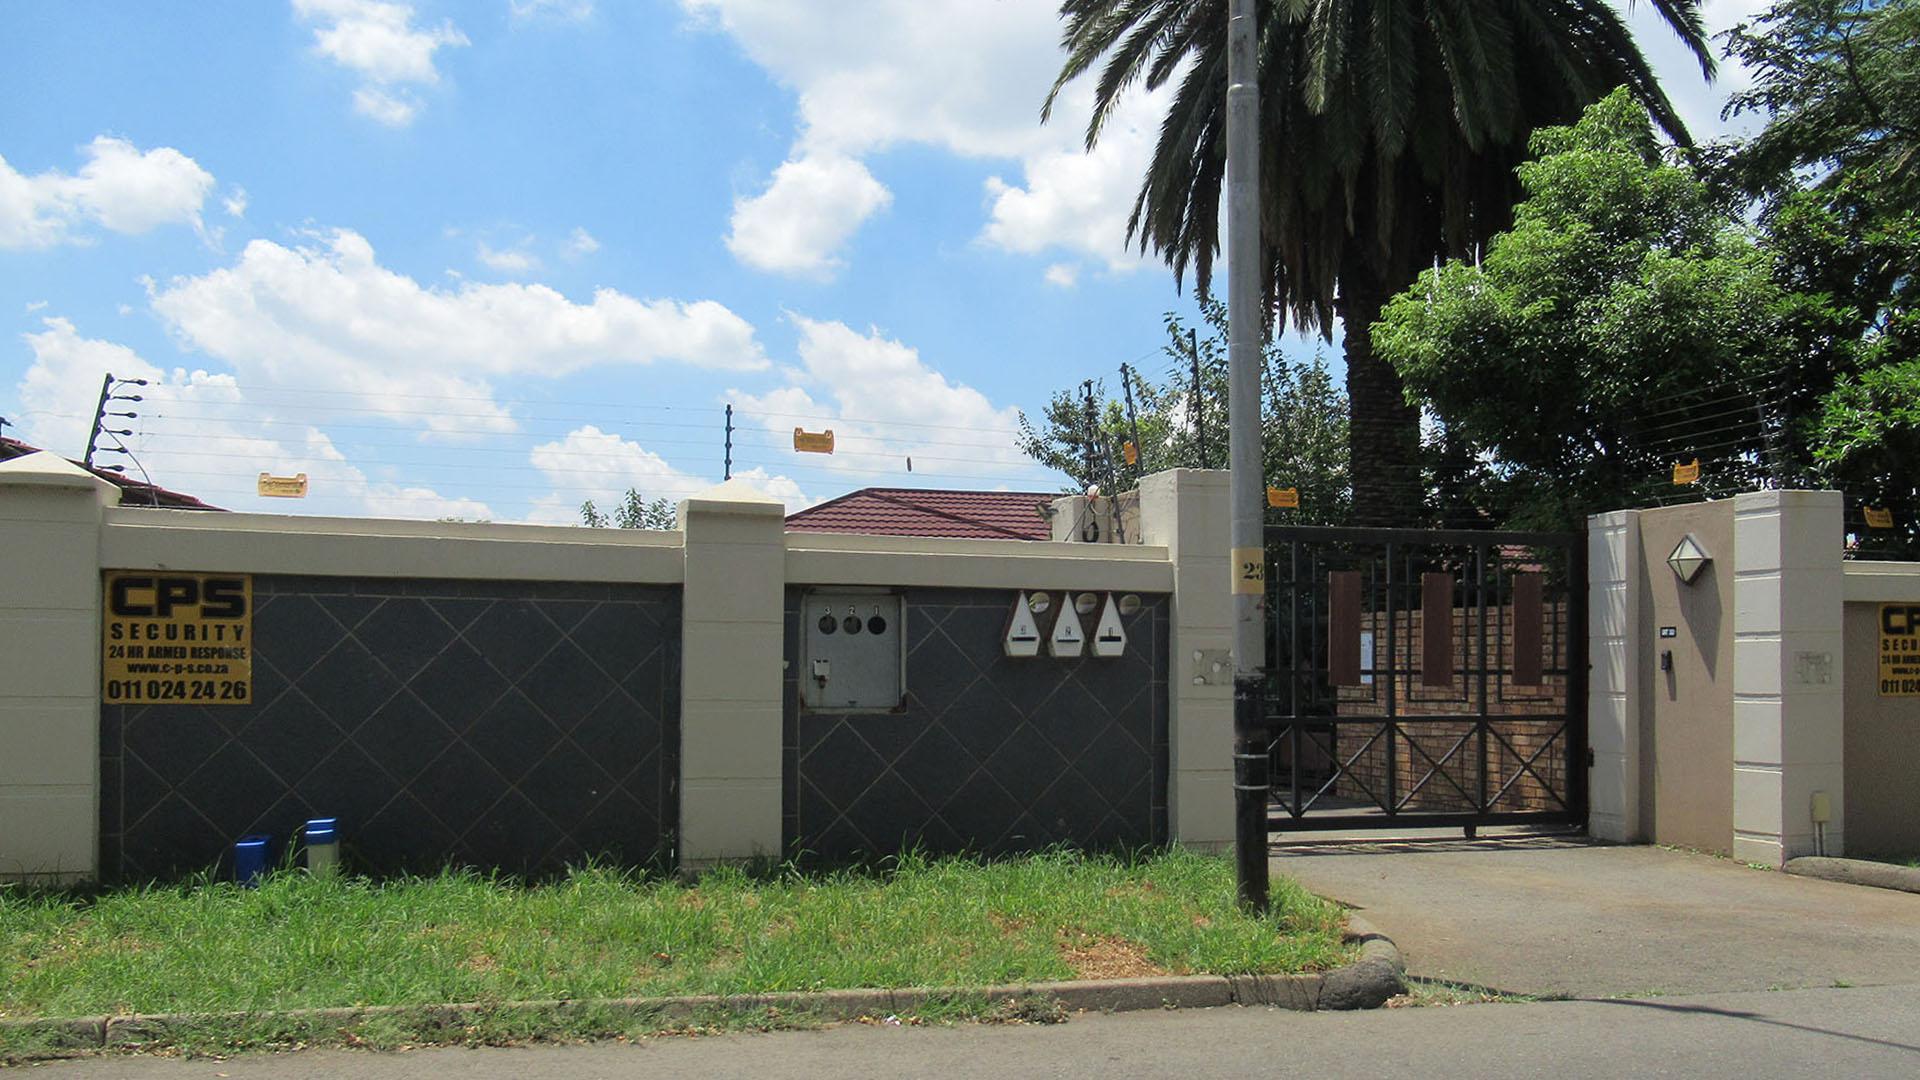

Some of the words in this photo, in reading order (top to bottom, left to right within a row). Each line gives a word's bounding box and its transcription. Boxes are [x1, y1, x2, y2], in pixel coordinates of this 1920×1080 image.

[111, 578, 247, 618] CPS
[111, 623, 246, 641] SECURITY
[109, 646, 125, 659] 24
[127, 646, 144, 659] HR
[147, 646, 187, 659] ARMED
[191, 647, 246, 660] RESPONSE
[127, 663, 229, 675] www.c-p-s.co.za
[108, 680, 142, 699] 011
[147, 680, 187, 699] 024
[191, 681, 217, 699] 24
[220, 681, 247, 700] 26
